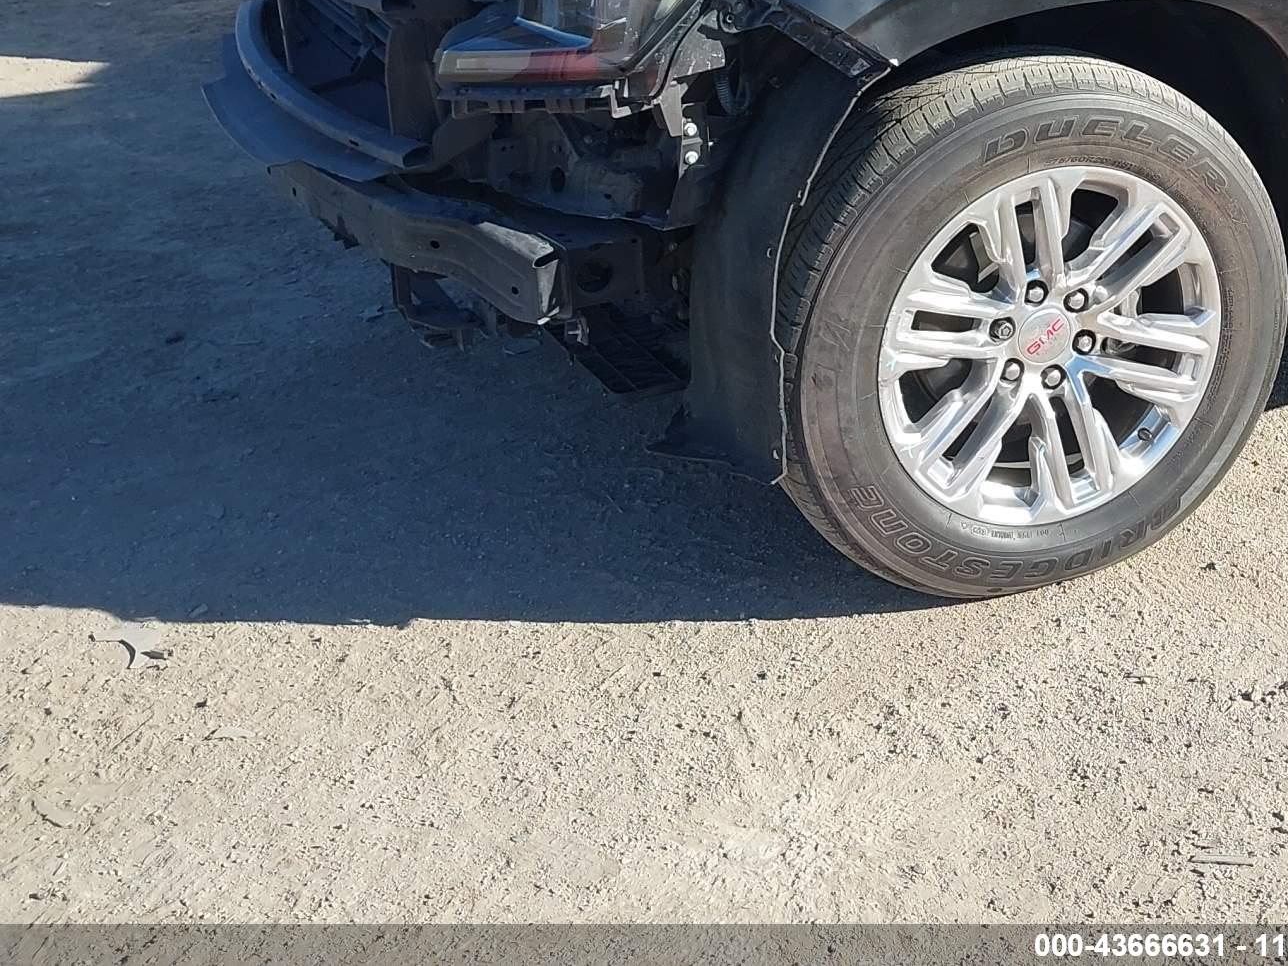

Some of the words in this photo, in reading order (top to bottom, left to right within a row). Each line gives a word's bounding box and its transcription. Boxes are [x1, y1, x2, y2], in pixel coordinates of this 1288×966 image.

[981, 114, 1229, 194] DUELER
[1026, 318, 1064, 355] GMC
[847, 483, 1182, 581] BRIDGESTONE
